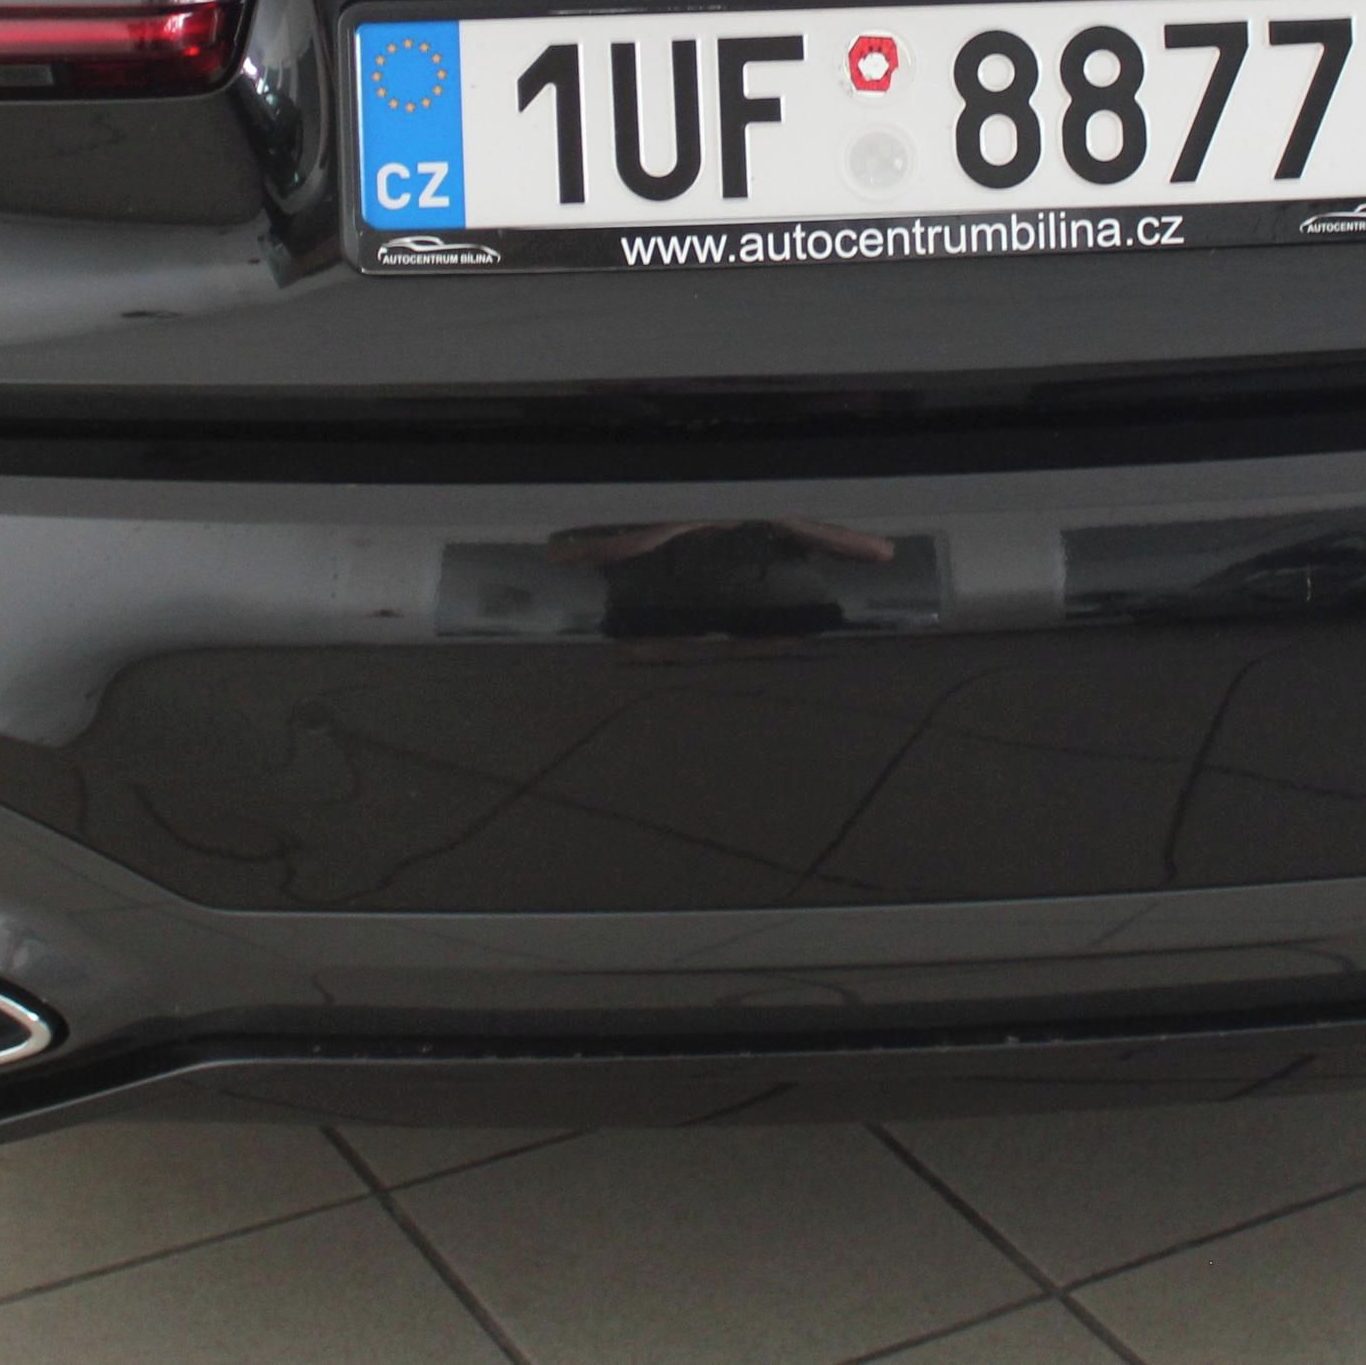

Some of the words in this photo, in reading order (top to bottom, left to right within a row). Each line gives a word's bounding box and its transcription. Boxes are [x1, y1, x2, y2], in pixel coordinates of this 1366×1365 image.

[516, 33, 806, 206] 1UF
[952, 17, 1355, 190] 8877
[376, 161, 451, 210] CZ
[382, 252, 458, 265] AUTOCENTRUM
[620, 213, 1185, 267] www.autocentrumbilina.cz
